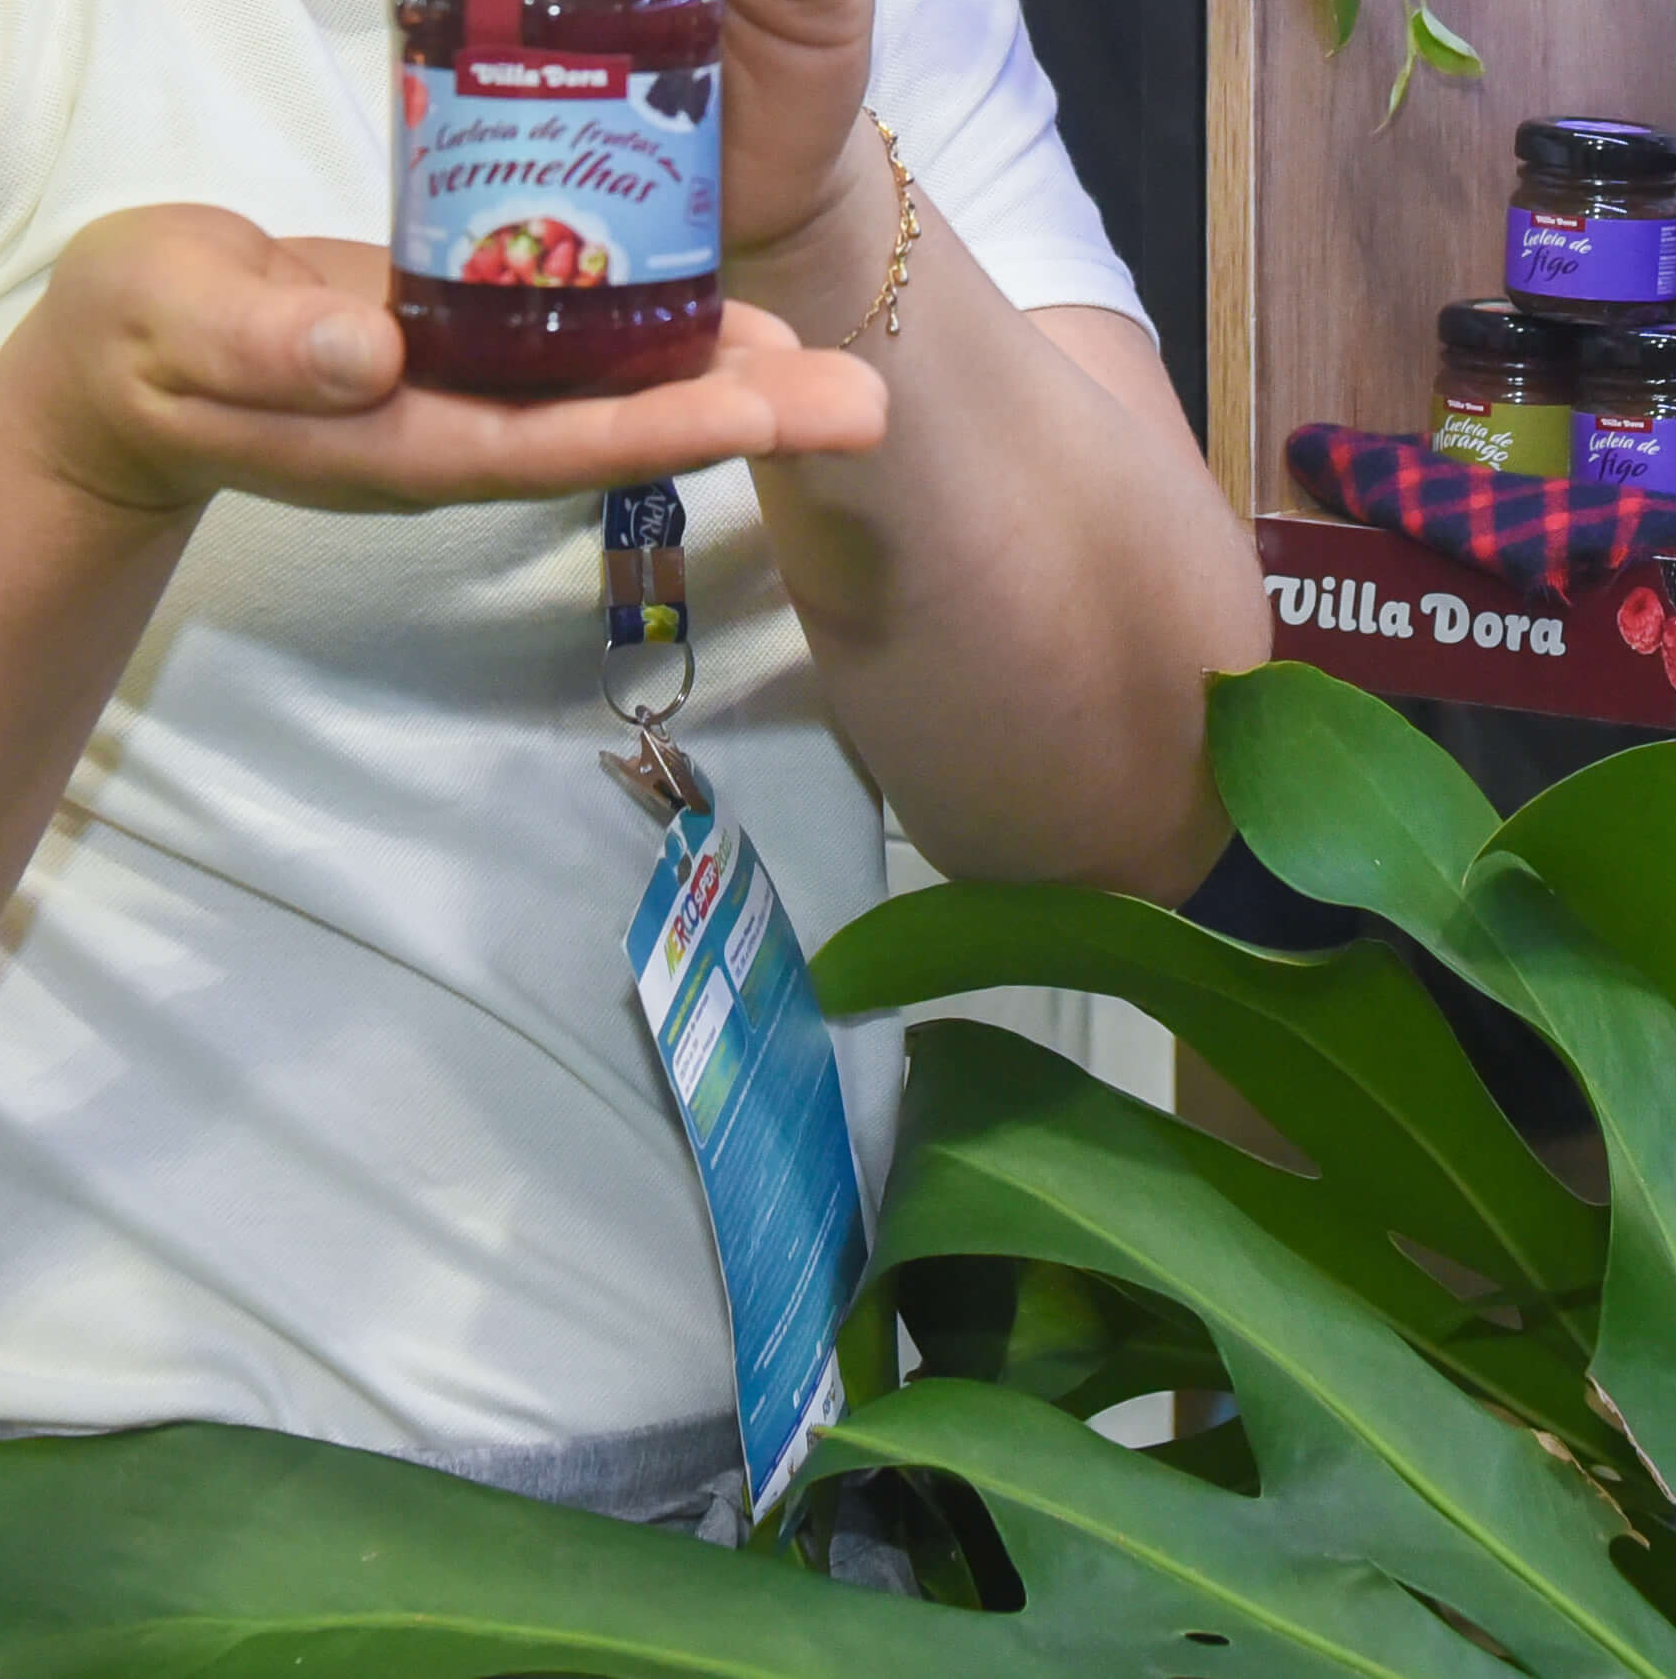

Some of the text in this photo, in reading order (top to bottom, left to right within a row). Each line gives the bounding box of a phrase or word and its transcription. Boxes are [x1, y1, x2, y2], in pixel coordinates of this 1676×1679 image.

[528, 115, 568, 142] de
[427, 150, 660, 204] vermelhas
[1523, 228, 1593, 254] Geleia de
[1525, 247, 1580, 283] figo
[1489, 431, 1514, 448] de
[1589, 431, 1661, 456] Geleia de
[1598, 449, 1648, 483] figo
[1263, 574, 1568, 657] Villa Dora
